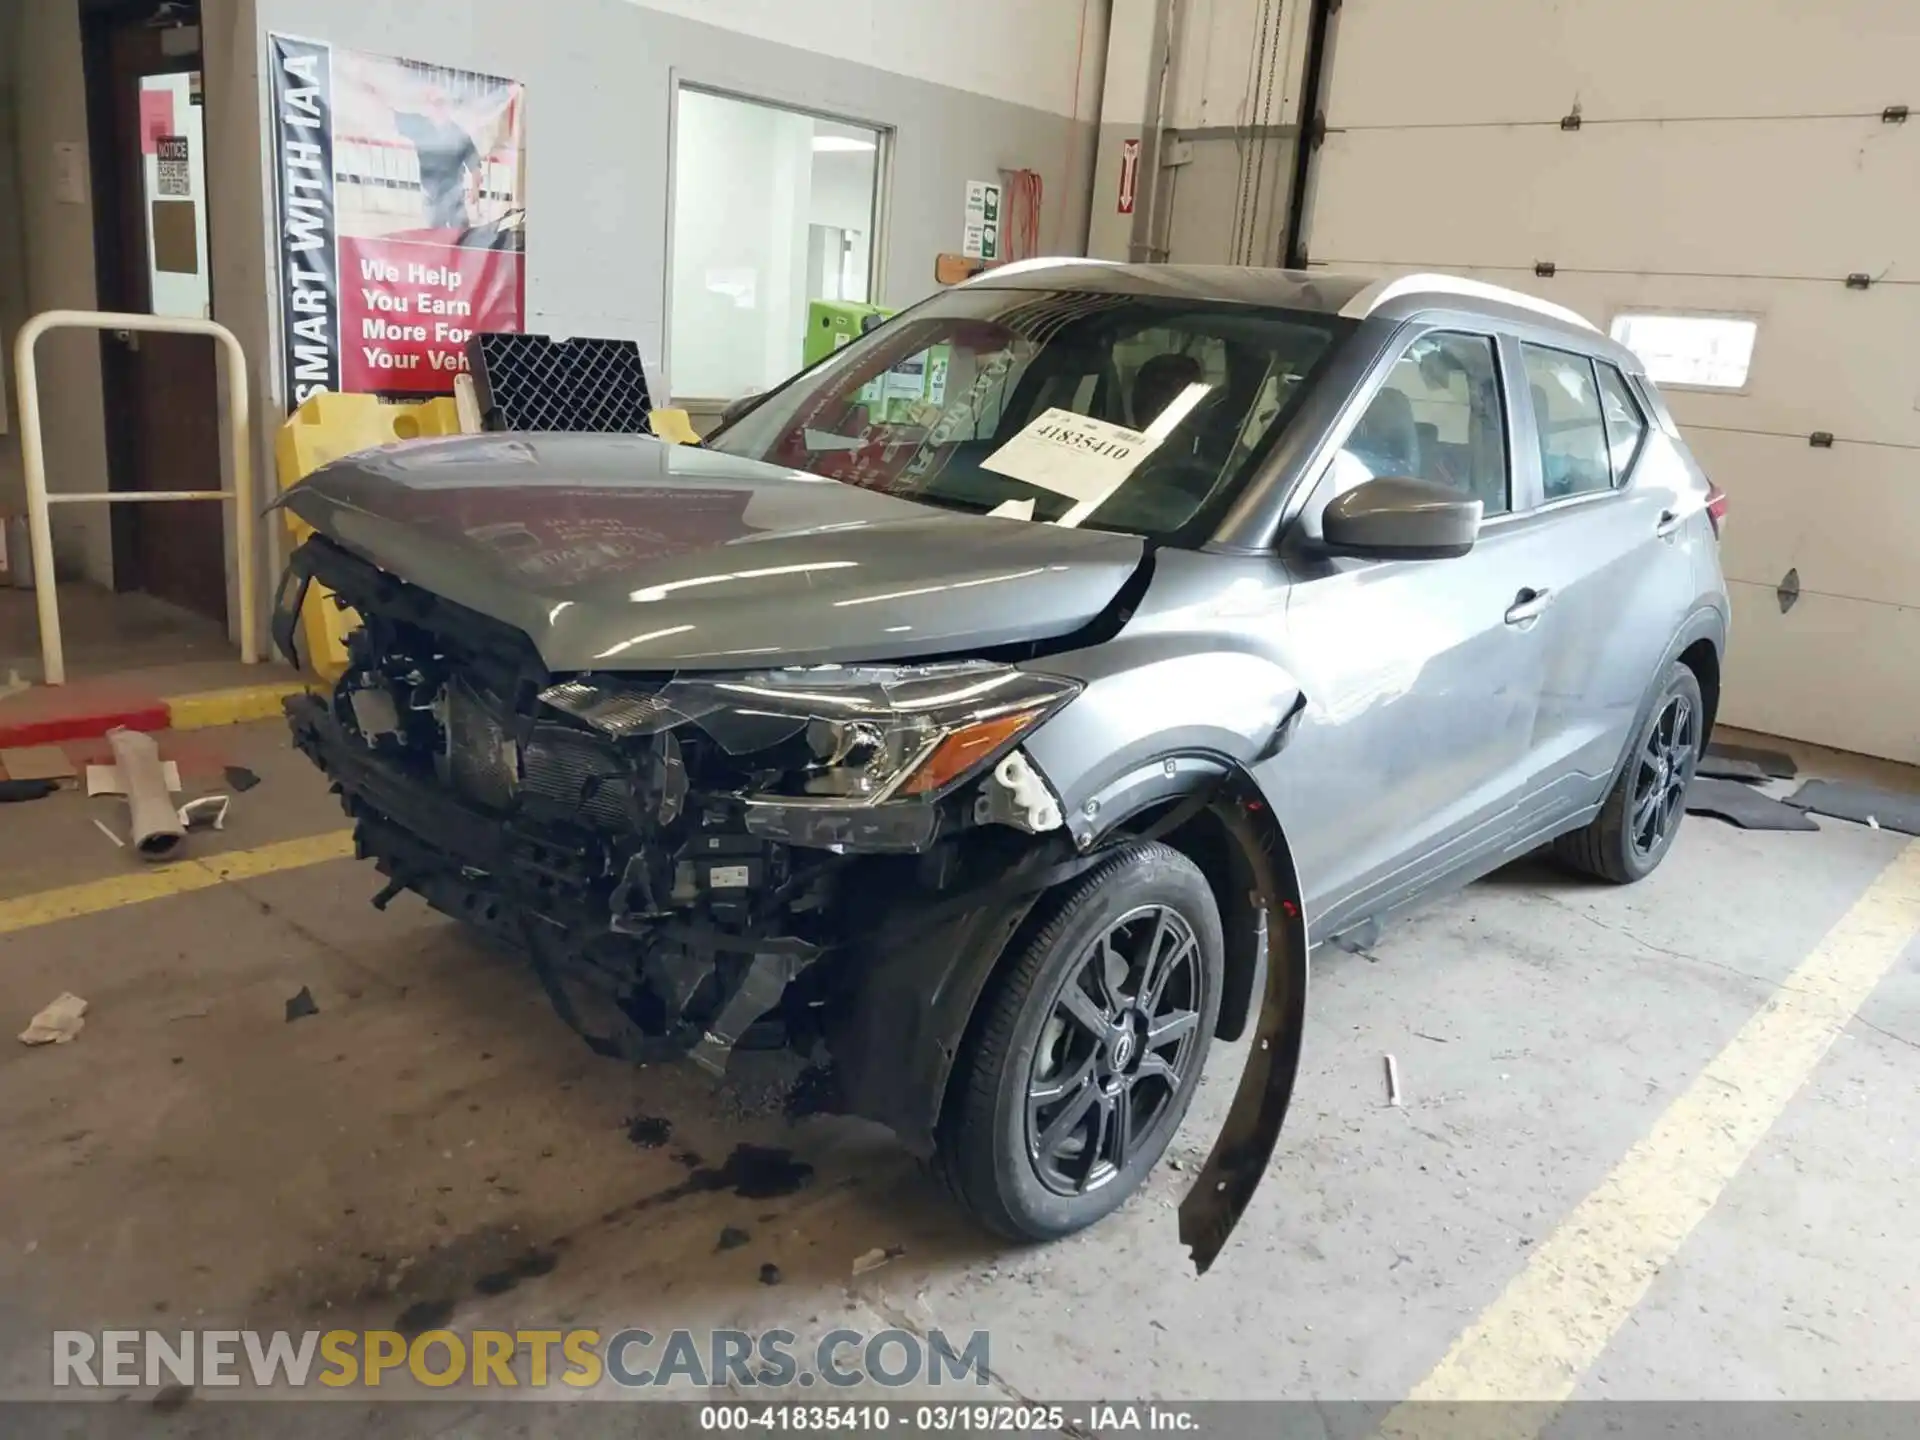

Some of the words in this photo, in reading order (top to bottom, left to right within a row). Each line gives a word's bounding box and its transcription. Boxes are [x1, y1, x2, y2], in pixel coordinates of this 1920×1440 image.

[283, 55, 320, 128] IAA
[158, 142, 187, 157] NOTICE
[285, 141, 324, 251] WITH
[361, 259, 399, 282] We
[408, 264, 461, 292] Help
[362, 289, 408, 312] You
[418, 294, 471, 316] Earn
[292, 262, 328, 407] SMART
[362, 319, 426, 342] More
[435, 323, 473, 342] For
[362, 347, 420, 369] Your
[1037, 424, 1130, 461] 41835410
